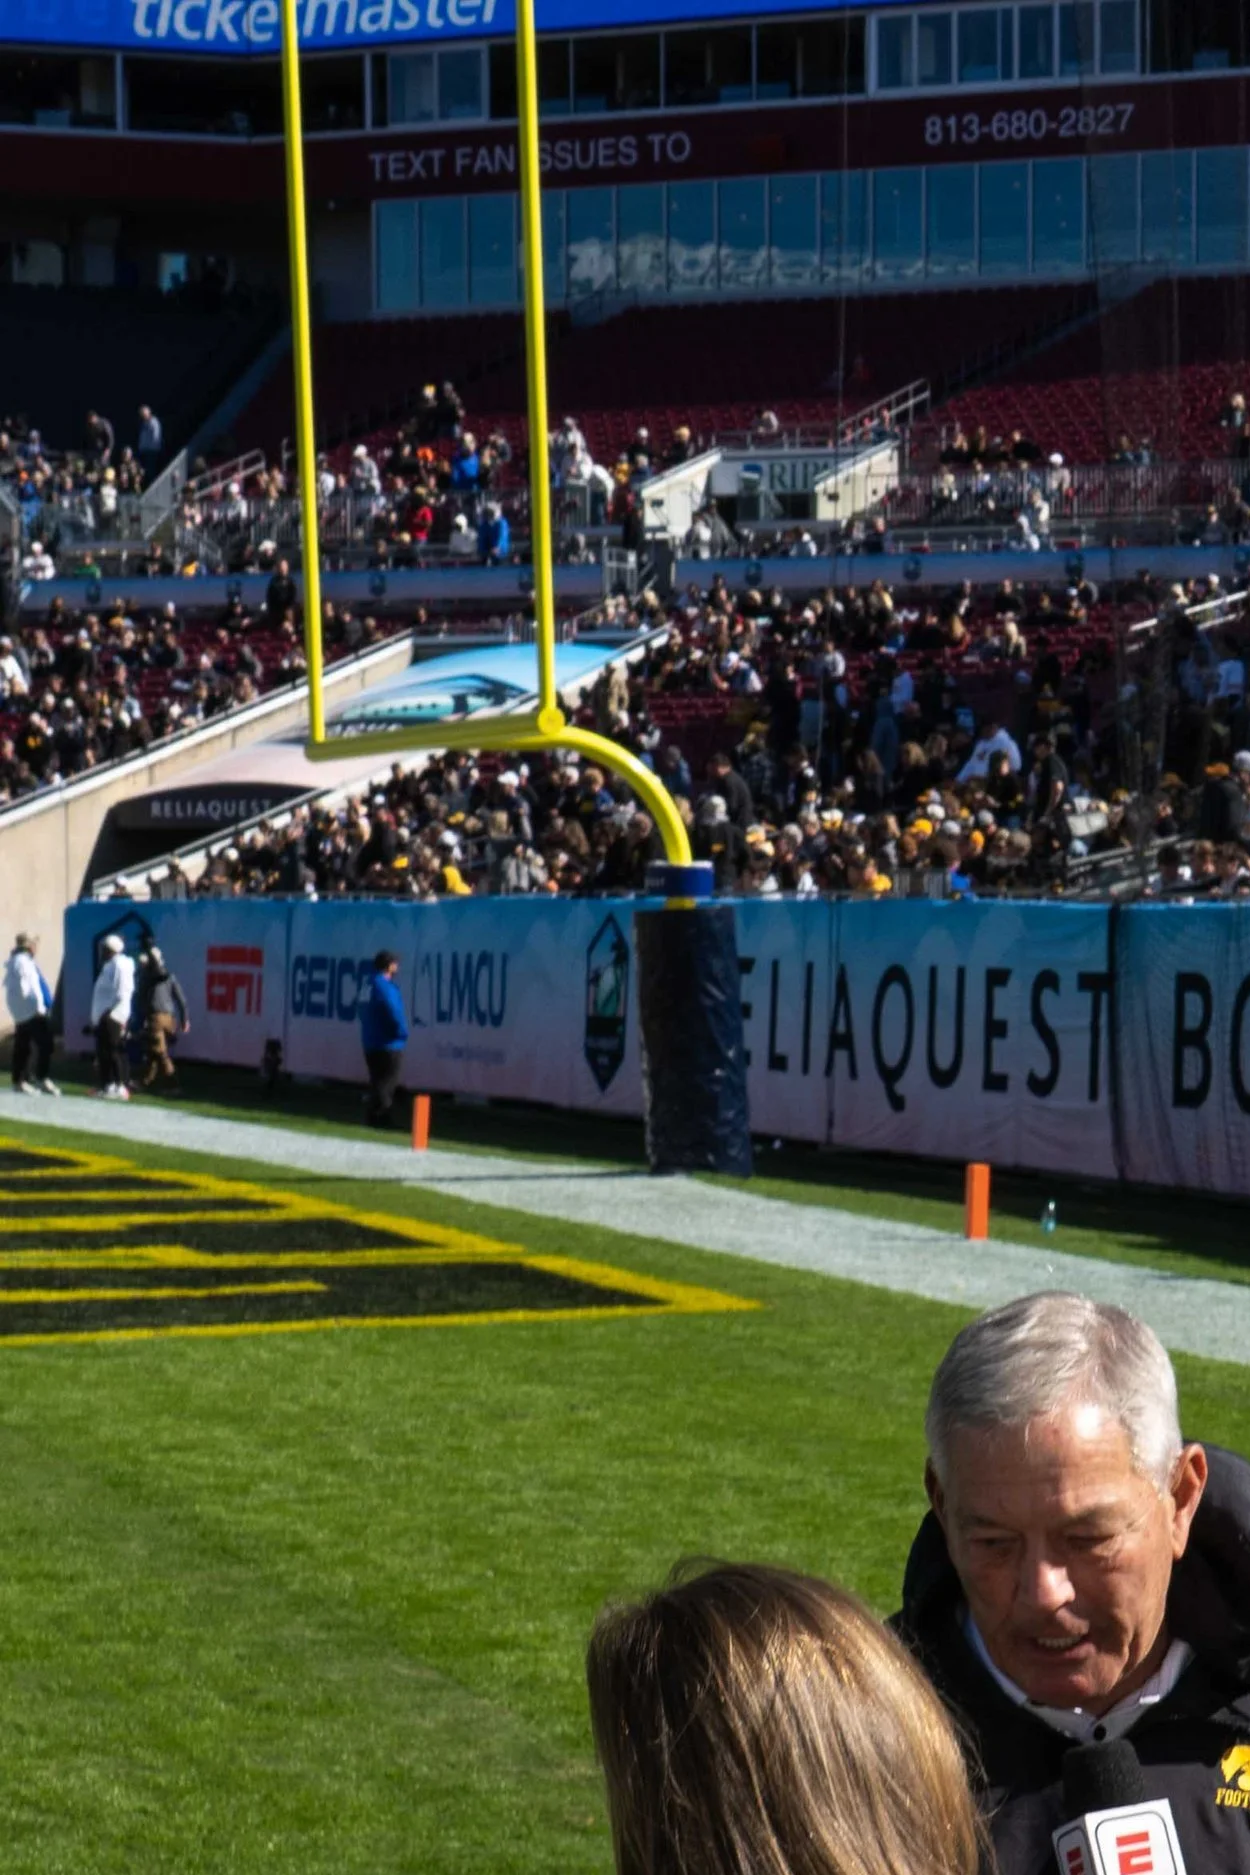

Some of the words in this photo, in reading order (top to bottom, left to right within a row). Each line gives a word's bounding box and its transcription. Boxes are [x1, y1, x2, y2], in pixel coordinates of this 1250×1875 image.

[924, 103, 1135, 146] 813-680-2827
[369, 149, 446, 181] TEXT
[455, 143, 515, 176] FAN
[538, 135, 639, 172] SSUES
[647, 132, 692, 163] TO
[150, 798, 272, 820] RELIAQUEST
[436, 950, 508, 1028] LMCU
